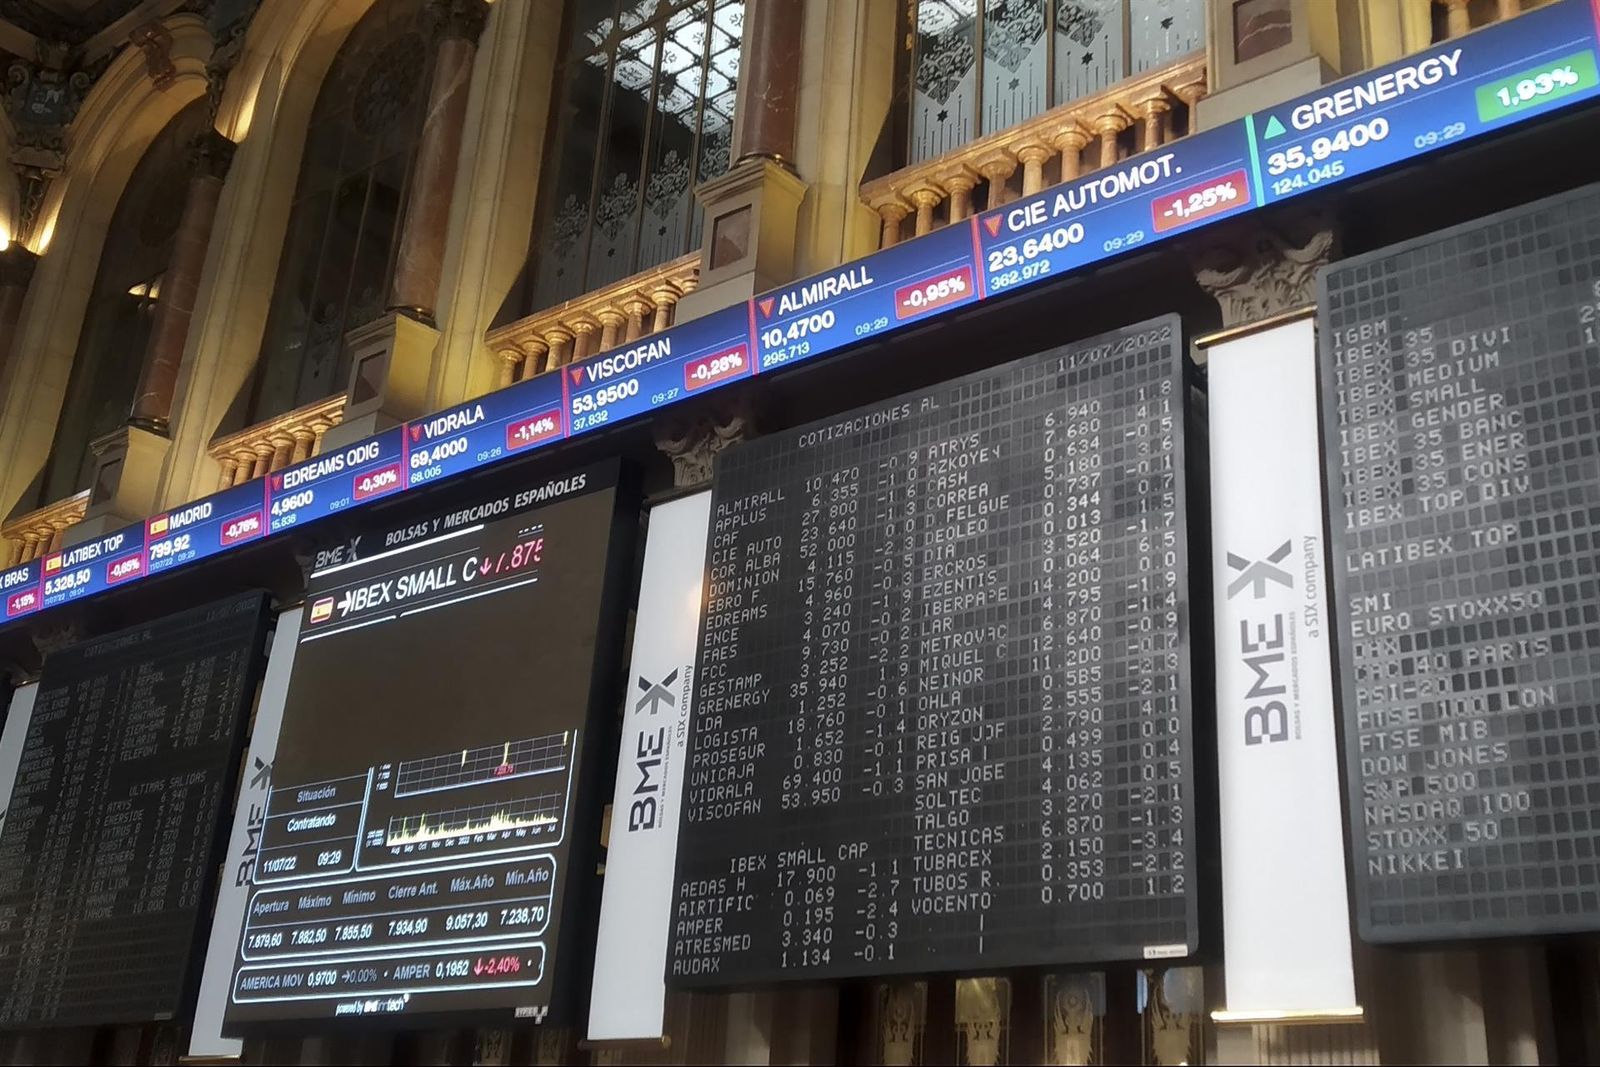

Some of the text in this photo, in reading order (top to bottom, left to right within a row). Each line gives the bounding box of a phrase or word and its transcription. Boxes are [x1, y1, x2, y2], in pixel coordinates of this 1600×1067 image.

[1291, 49, 1464, 130] GRENERGY
[1496, 66, 1579, 108] 1,93%
[1267, 118, 1390, 177] 35,9400
[1272, 160, 1345, 195] 124.045
[1008, 153, 1182, 232] CIE AUTOMOT.
[1163, 182, 1238, 219] -1,25%
[988, 223, 1084, 272] 23,6400
[1103, 230, 1144, 252] 09:29
[991, 261, 1050, 291] 362.972
[778, 266, 874, 316] ALMIRALL
[903, 276, 966, 308] -0,95%
[761, 311, 835, 349] 10,4700
[856, 317, 888, 336] 09:29
[1334, 320, 1387, 348] IGBM
[586, 338, 672, 382] VISCOFAN
[763, 342, 809, 366] 295.713
[1335, 327, 1433, 367] IBEX 35
[690, 354, 742, 381] -0,28%
[1338, 351, 1499, 406] IBEX MEDIUM
[572, 379, 639, 415] 53,9500
[652, 388, 679, 404] 09:27
[799, 326, 1171, 448] COTIZACIONES AL 11/07/2022
[1339, 379, 1485, 426] IBEX SMALL
[423, 405, 484, 439] VIDRALA
[514, 418, 554, 440] -1,14%
[574, 410, 609, 431] 37.832
[1340, 393, 1504, 446] IBEX GENDER
[411, 438, 468, 469] 69,4000
[929, 433, 979, 460] ATRYS
[283, 441, 380, 489] EDREAMS ODIG
[411, 466, 442, 484] 68.005
[358, 471, 397, 492] -0,30%
[928, 471, 968, 493] CASH
[271, 492, 313, 517] 4,9600
[717, 488, 785, 517] ALMIRALL
[927, 483, 988, 510] CORREA
[169, 502, 212, 530] MADRID
[315, 474, 586, 569] BME BOLSAS Y MERCADOS ESPAÑOLES
[715, 508, 767, 533] APPLUS
[714, 531, 739, 549] CAF
[925, 518, 987, 545] DEOLEO
[62, 534, 124, 568] LATIBEX TOP
[150, 535, 190, 560] 799,92
[712, 536, 782, 565] CIE AUTO
[925, 544, 955, 563] DIA
[1347, 524, 1517, 572] LATIBEX TOP
[4, 568, 29, 590] BRAS
[45, 569, 91, 596] 5.328,50
[350, 580, 394, 611] IBEX
[396, 564, 456, 600] SMALL
[462, 557, 478, 582] C
[709, 569, 779, 597] DOMINION
[923, 570, 997, 599] EZENTIS
[1304, 536, 1319, 639] a SIX company
[707, 594, 742, 613] EBRO
[1351, 593, 1392, 616] SMI
[1352, 591, 1542, 638] EURO STOXX50
[706, 605, 768, 630] EDREAMS
[704, 627, 739, 647] ENCE
[703, 644, 738, 664] FAES
[680, 665, 693, 717] company
[699, 673, 762, 698] GESTAMP
[919, 668, 984, 692] NEINOR
[1240, 613, 1289, 746] BME
[698, 688, 770, 715] GRENERGY
[677, 719, 686, 738] SIX
[918, 706, 983, 730] ORYZON
[695, 727, 758, 751] LOGISTA
[1360, 720, 1488, 752] FTSE MIB
[693, 743, 766, 769] PROSEGUR
[1362, 743, 1508, 776] DOW JONES
[628, 727, 665, 832] BME
[691, 763, 754, 787] UNICAJA
[297, 786, 336, 803] Situación
[690, 781, 753, 804] VIDRALA
[915, 788, 981, 811] SOLTEC
[287, 813, 336, 832] Contratando
[688, 798, 761, 823] VISCOFAN
[915, 809, 969, 831] TALGO
[1365, 792, 1530, 826] NASDAQ 100
[914, 826, 1004, 851] TECNICAS
[1367, 821, 1498, 850] STOXX 50
[263, 850, 341, 873] 11/07/22 09:29
[730, 842, 868, 874] IBEX SMALL CAP
[913, 849, 991, 872] TUBACEX
[1369, 849, 1464, 876] NIKKEI
[253, 868, 549, 917] Apertura Máximo Mínimo Cierre Ant. Máx.Año Mín.Año
[681, 879, 726, 898] AEDAS
[737, 877, 745, 891] H
[678, 895, 754, 917] AIRTIFIC
[912, 892, 991, 915] VOCENTO
[248, 906, 544, 949] 7.879,60 7.882,50 7.855,50 7.934,90 9.057,30 7.238,70
[677, 918, 723, 937] AMPER
[675, 934, 751, 956] ATRESMED
[240, 977, 280, 990] AMERICA
[282, 974, 304, 987] MOV
[307, 971, 337, 988] 0,9700
[393, 965, 430, 980] AMPER
[435, 960, 469, 979] 0,1952
[673, 957, 721, 976] AUDAX
